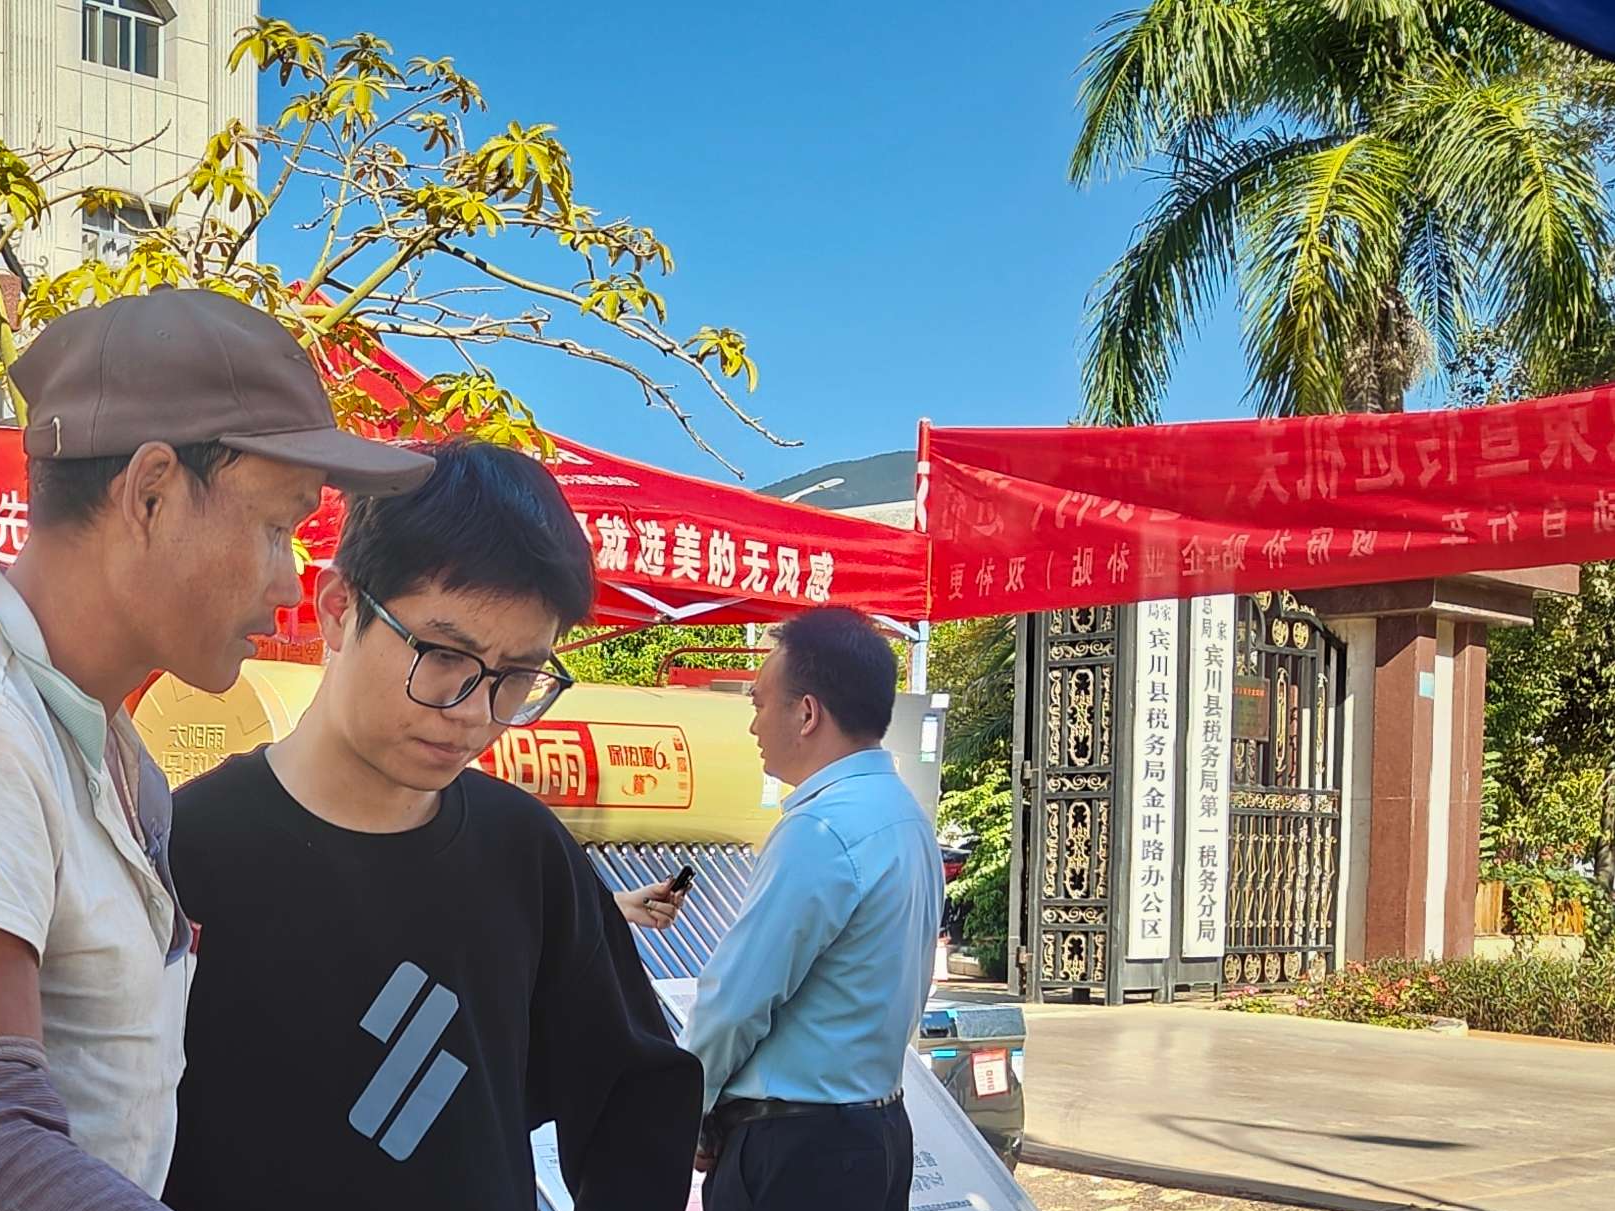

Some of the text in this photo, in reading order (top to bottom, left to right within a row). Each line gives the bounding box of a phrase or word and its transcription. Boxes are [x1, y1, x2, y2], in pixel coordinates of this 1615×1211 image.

[1140, 627, 1171, 940] 宾川县税务局金叶路办公区
[1196, 643, 1225, 943] 宾川县税务局第一税务分局
